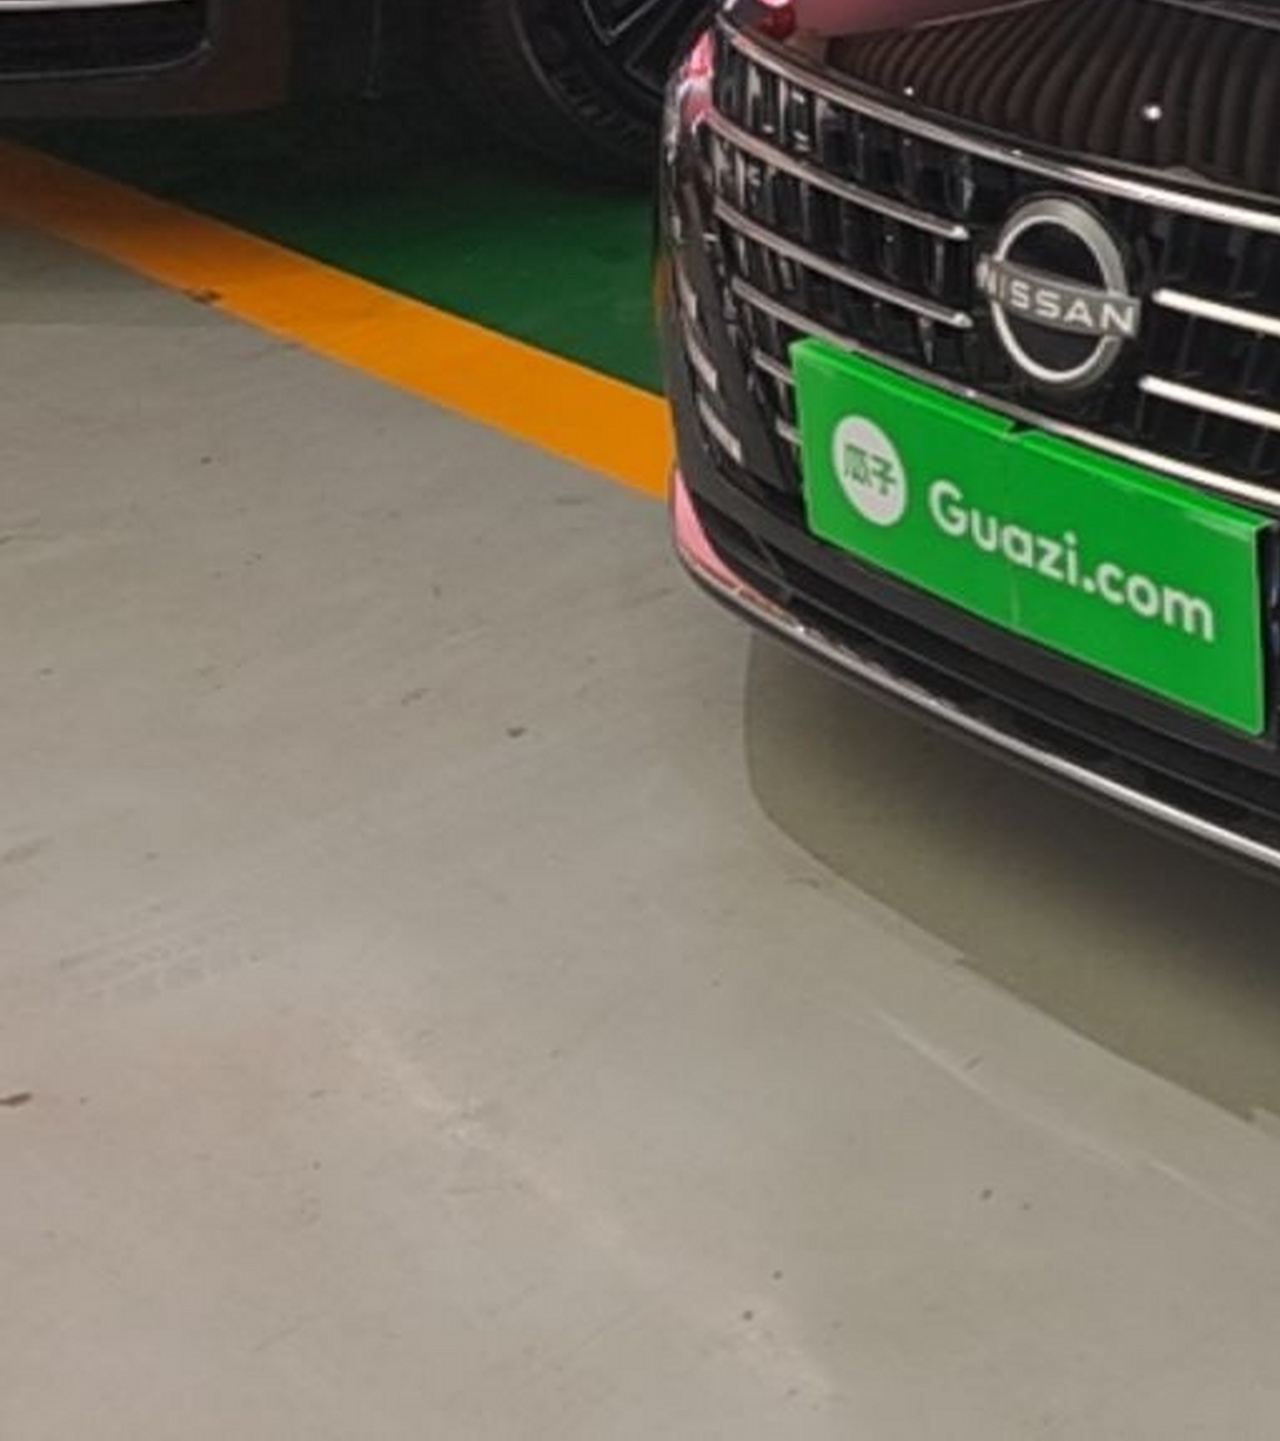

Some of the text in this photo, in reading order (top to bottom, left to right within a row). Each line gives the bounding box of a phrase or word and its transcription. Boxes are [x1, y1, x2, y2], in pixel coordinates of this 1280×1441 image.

[976, 258, 1134, 334] NISSAN
[843, 441, 898, 496] 瓜子
[929, 480, 1215, 642] Guazi.com
